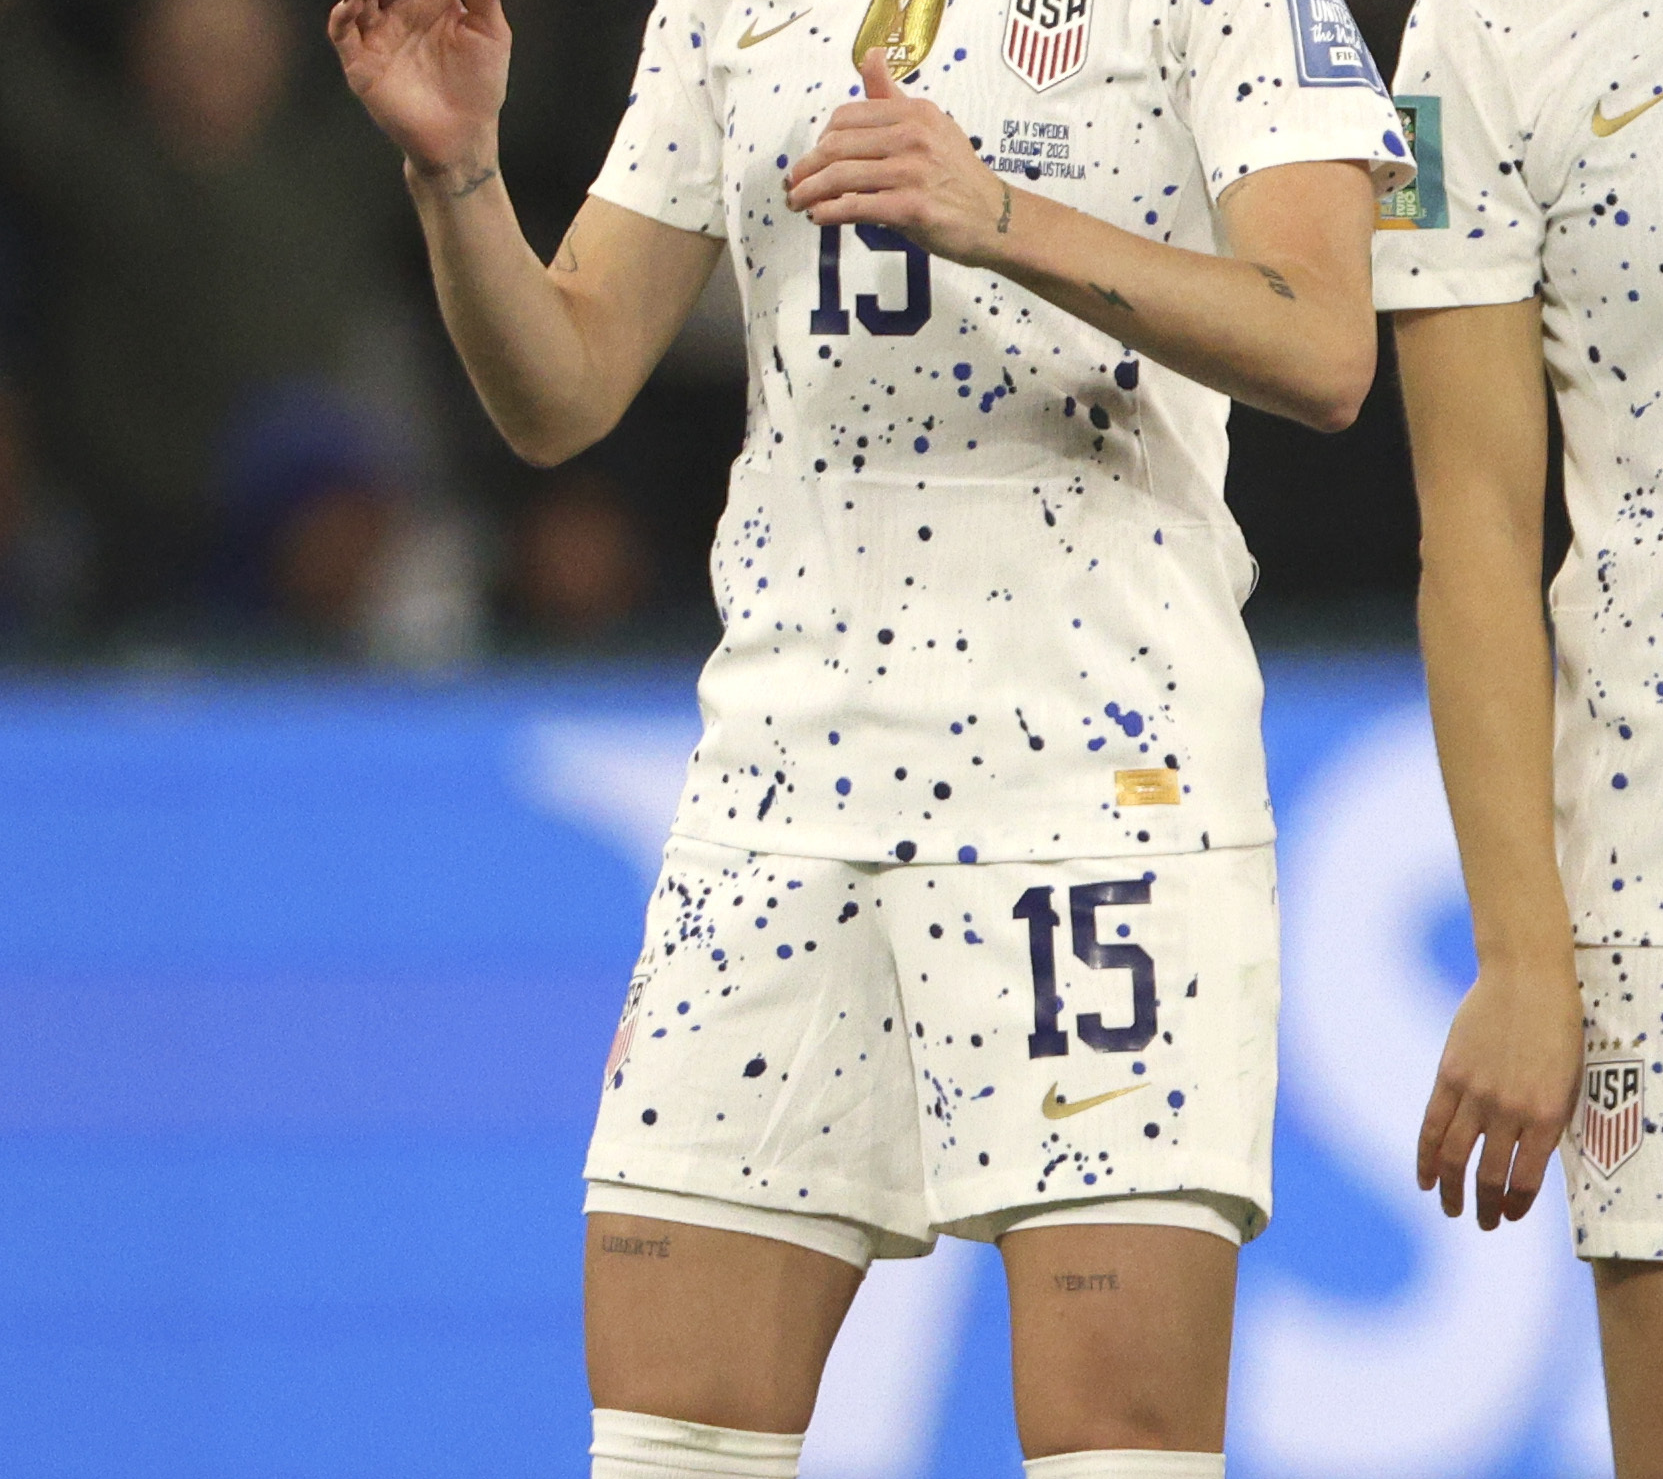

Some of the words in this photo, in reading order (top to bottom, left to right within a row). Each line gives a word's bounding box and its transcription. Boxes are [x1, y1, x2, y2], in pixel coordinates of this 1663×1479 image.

[1003, 119, 1020, 139] USA
[1032, 122, 1069, 140] SWEDEN
[1000, 138, 1006, 153] 6
[1046, 142, 1069, 158] 2023
[1011, 879, 1159, 1061] 15
[1588, 1067, 1640, 1111] USA
